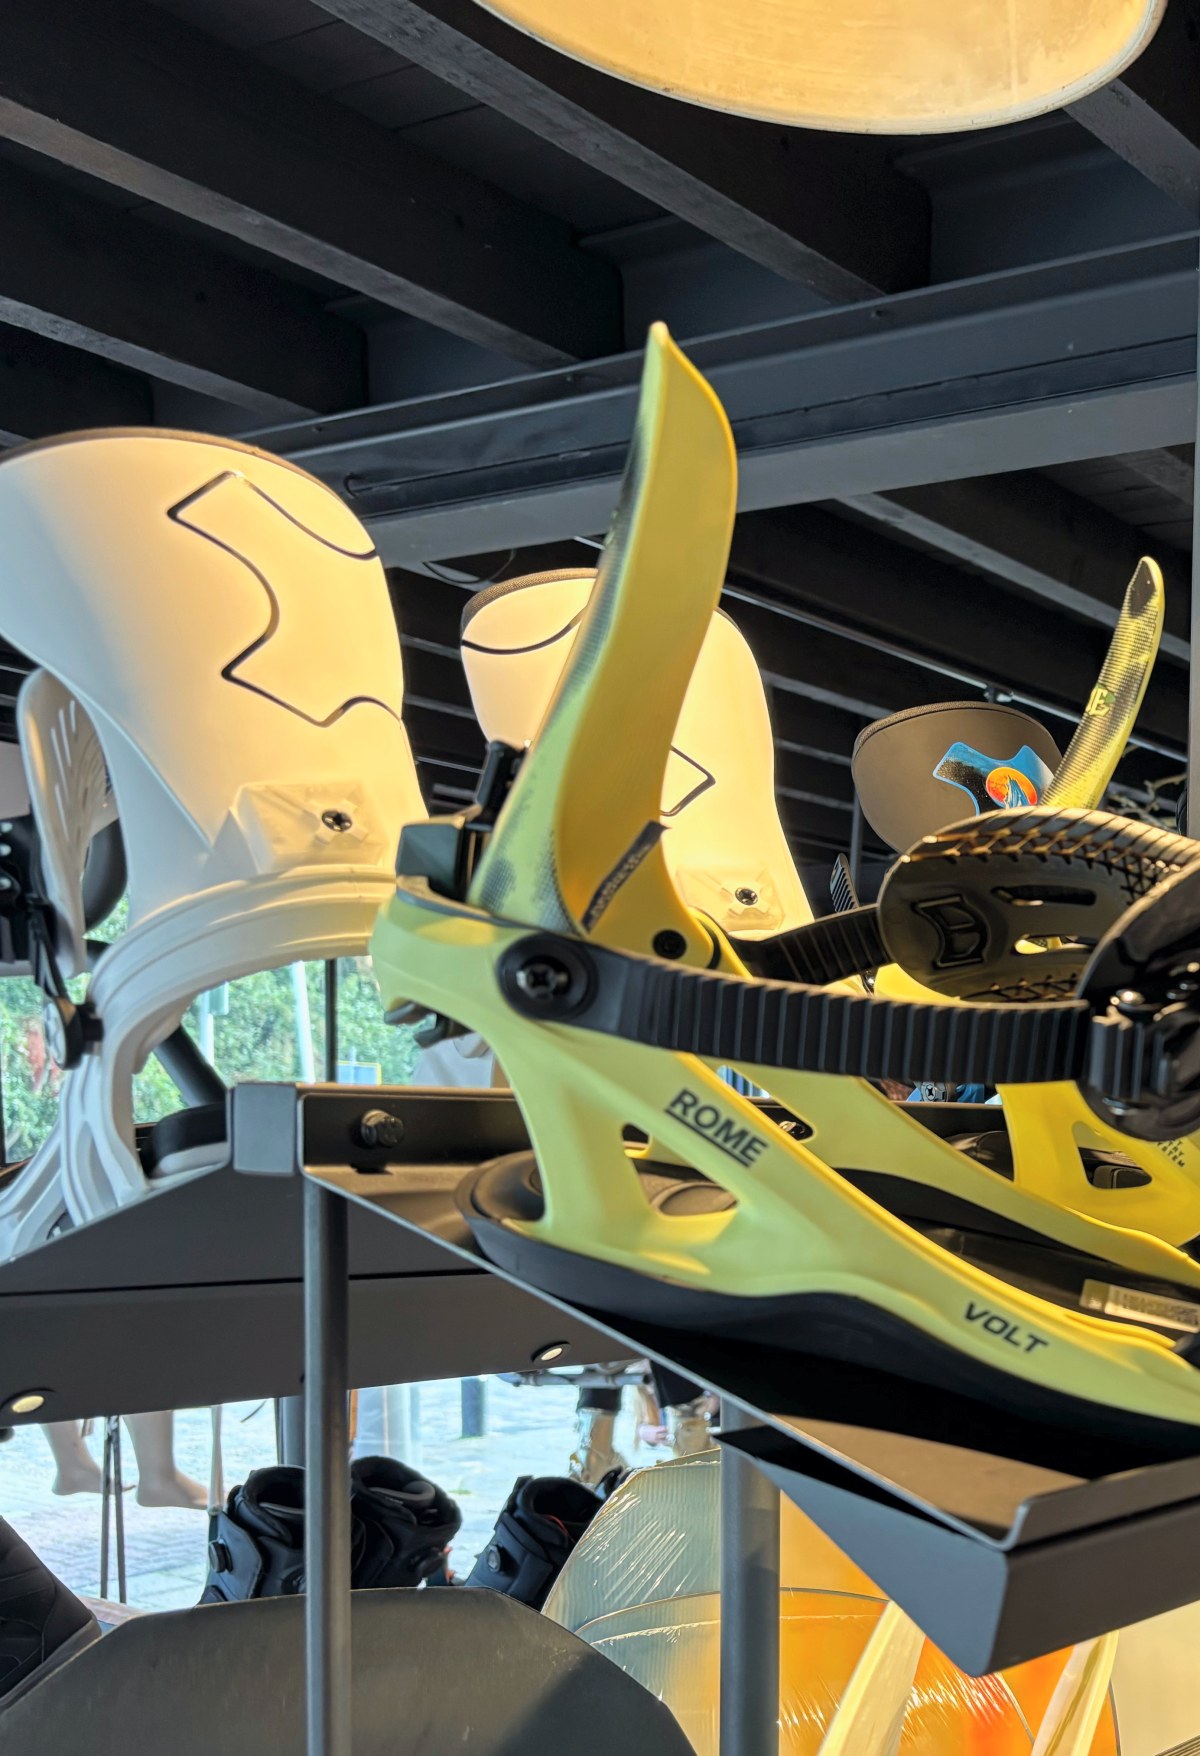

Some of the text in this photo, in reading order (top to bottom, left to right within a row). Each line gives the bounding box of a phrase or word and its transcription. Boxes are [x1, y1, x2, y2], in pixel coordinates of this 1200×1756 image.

[669, 1088, 769, 1163] ROME
[1156, 1142, 1185, 1167] YSTEM
[965, 1301, 1049, 1353] VOLT
